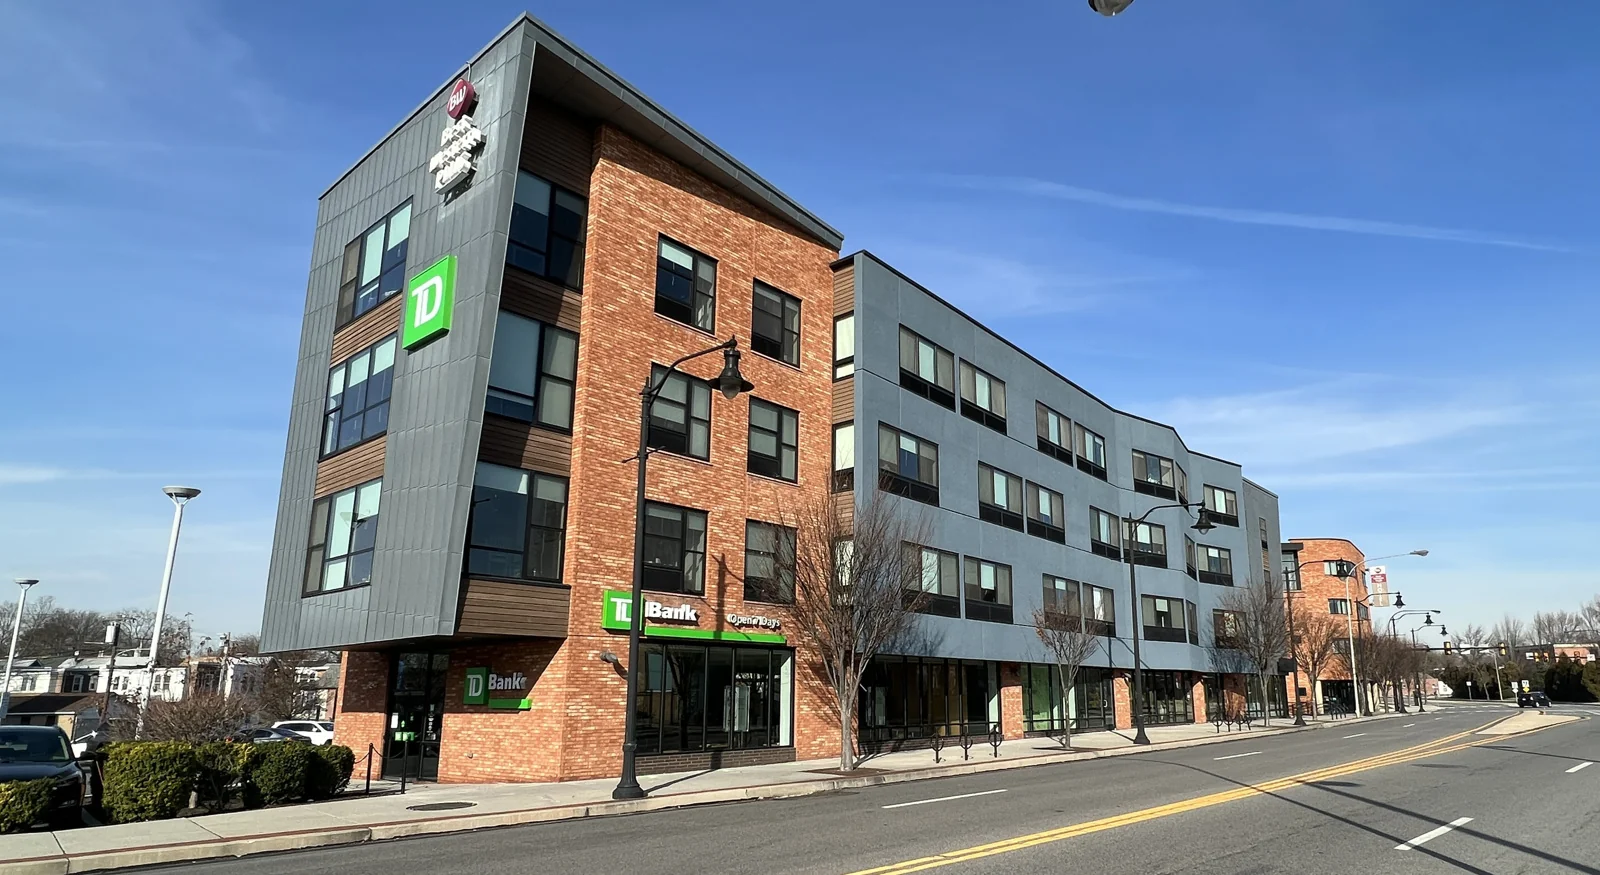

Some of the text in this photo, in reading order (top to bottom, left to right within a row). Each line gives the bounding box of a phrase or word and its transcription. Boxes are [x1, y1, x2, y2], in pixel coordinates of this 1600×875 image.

[448, 85, 467, 112] BW
[411, 275, 443, 329] TD
[645, 601, 697, 621] Bank
[727, 613, 752, 626] Open
[759, 616, 780, 629] Days
[467, 672, 526, 697] TD Bank
